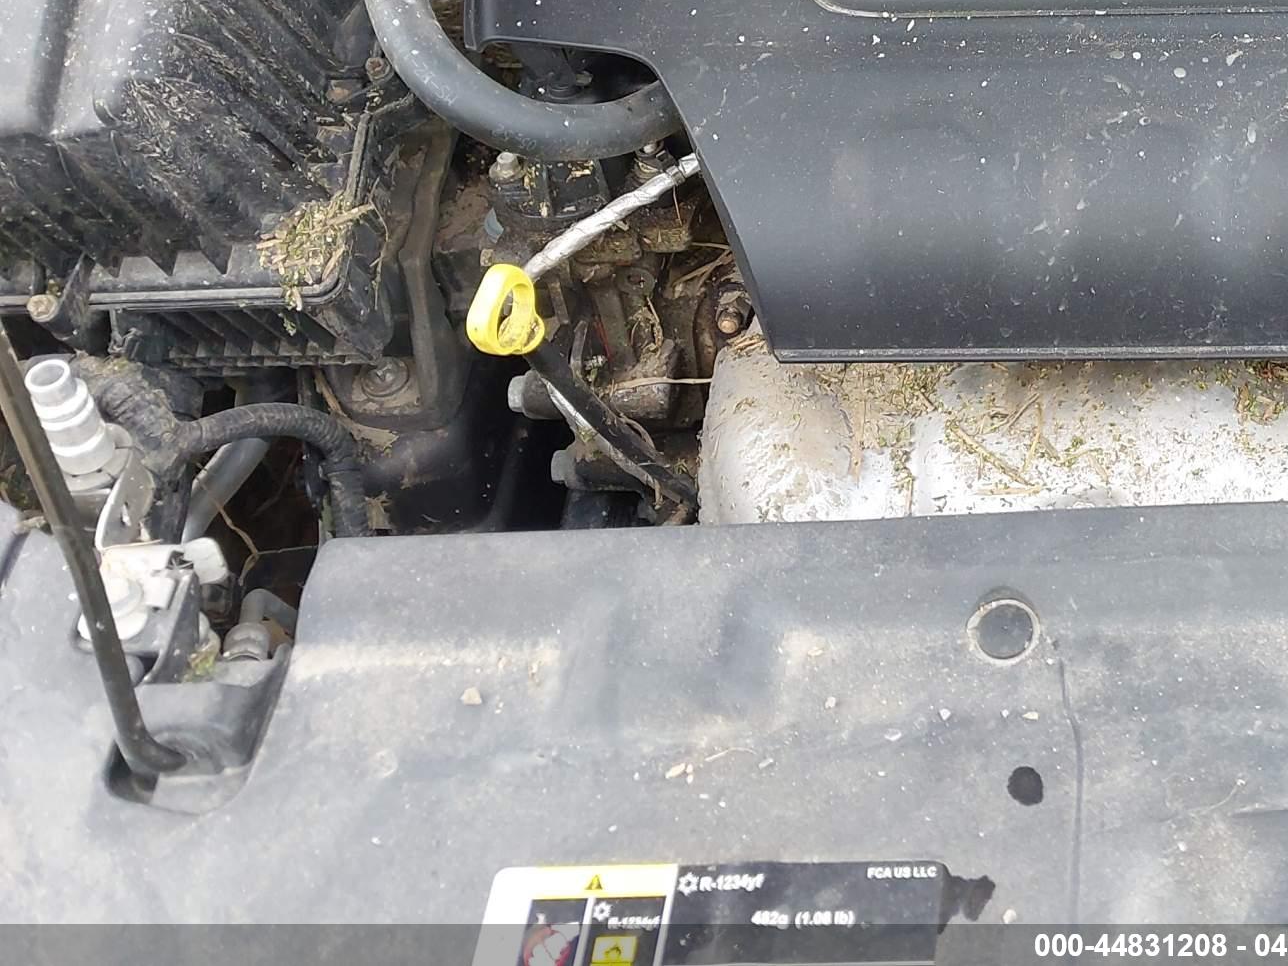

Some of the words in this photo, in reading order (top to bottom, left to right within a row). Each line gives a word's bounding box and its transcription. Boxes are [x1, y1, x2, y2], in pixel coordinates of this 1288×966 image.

[867, 866, 892, 879] FCA
[894, 866, 911, 879] US
[913, 866, 937, 878] LLC
